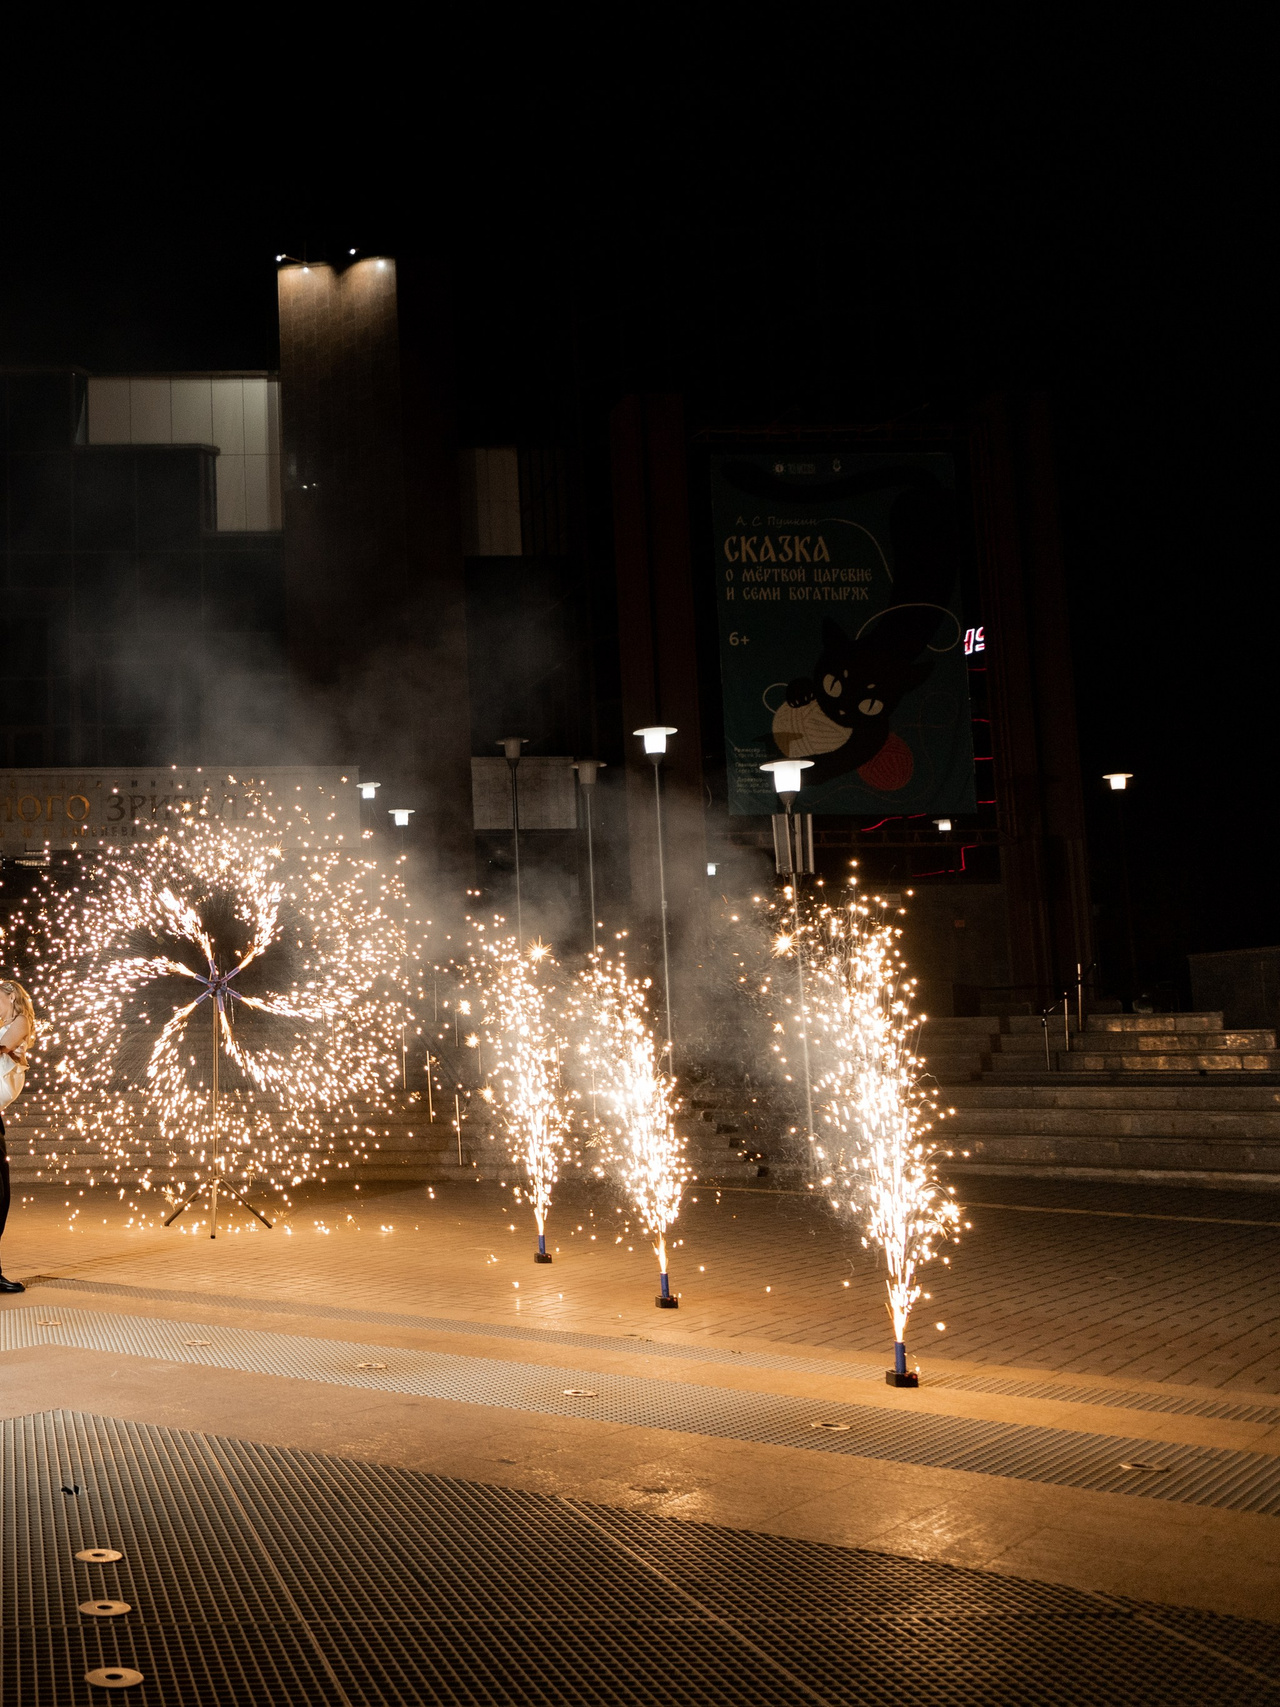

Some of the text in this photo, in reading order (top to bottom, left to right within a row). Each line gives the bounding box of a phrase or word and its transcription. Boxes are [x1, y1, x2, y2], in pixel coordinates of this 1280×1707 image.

[723, 534, 831, 564] СКАЗКА
[725, 566, 873, 584] О МЁРТВОЙ ЦАРЕВНЕ
[726, 586, 869, 601] И СЕМИ БОГАТЫРЯХ
[728, 631, 750, 647] 6+
